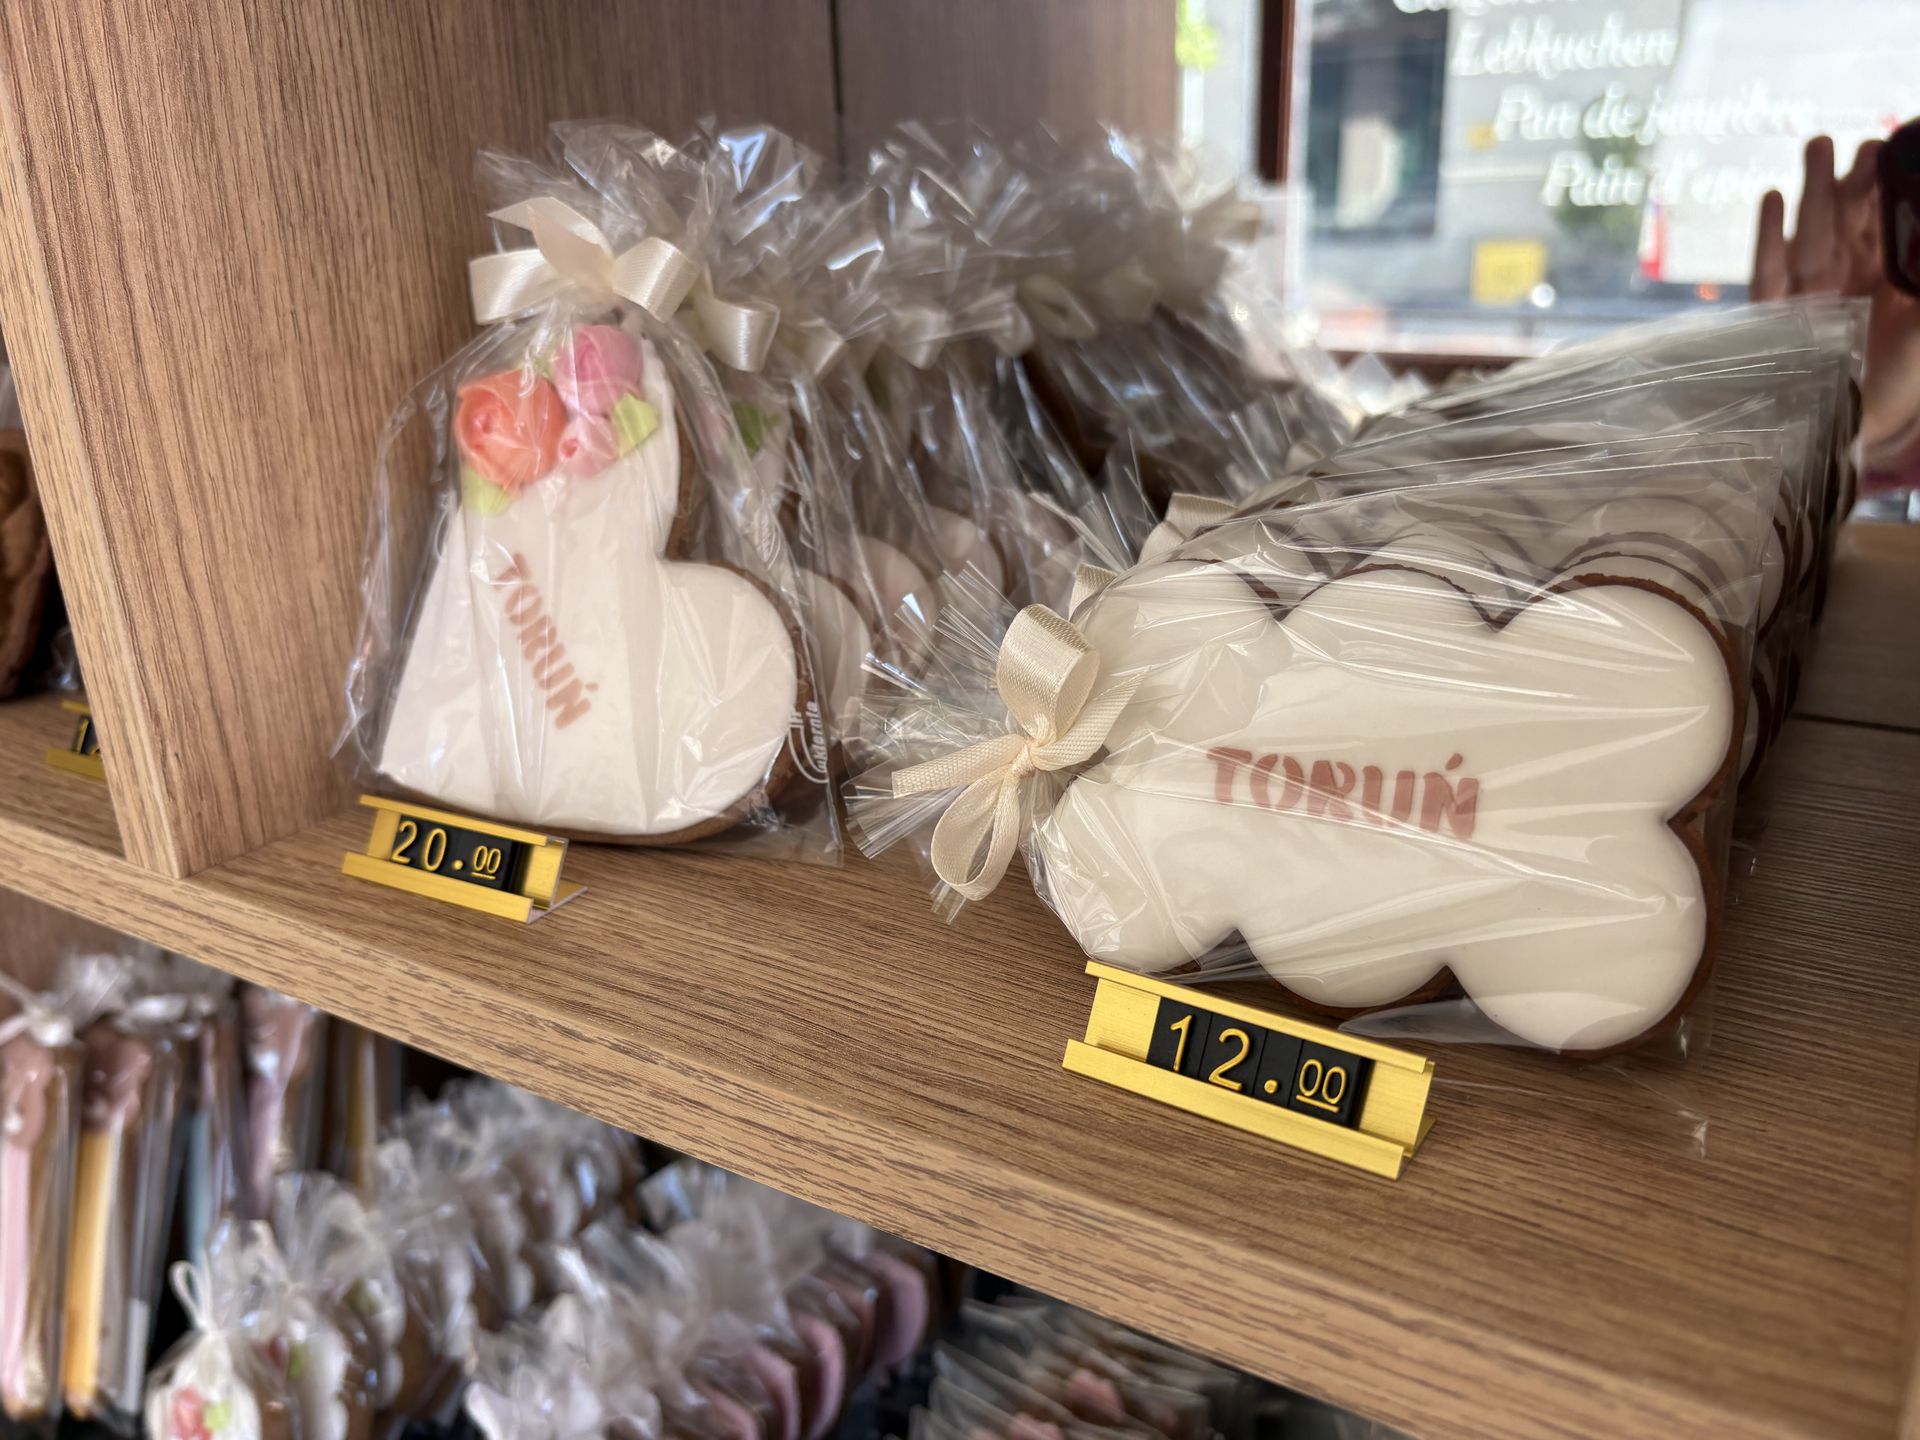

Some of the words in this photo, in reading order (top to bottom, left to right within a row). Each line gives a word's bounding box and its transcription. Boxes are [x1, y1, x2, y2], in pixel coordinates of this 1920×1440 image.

[494, 552, 599, 730] TORUŃ
[1207, 747, 1479, 839] TORUŃ
[392, 821, 502, 878] 20.00
[1170, 1014, 1347, 1109] 12.00
